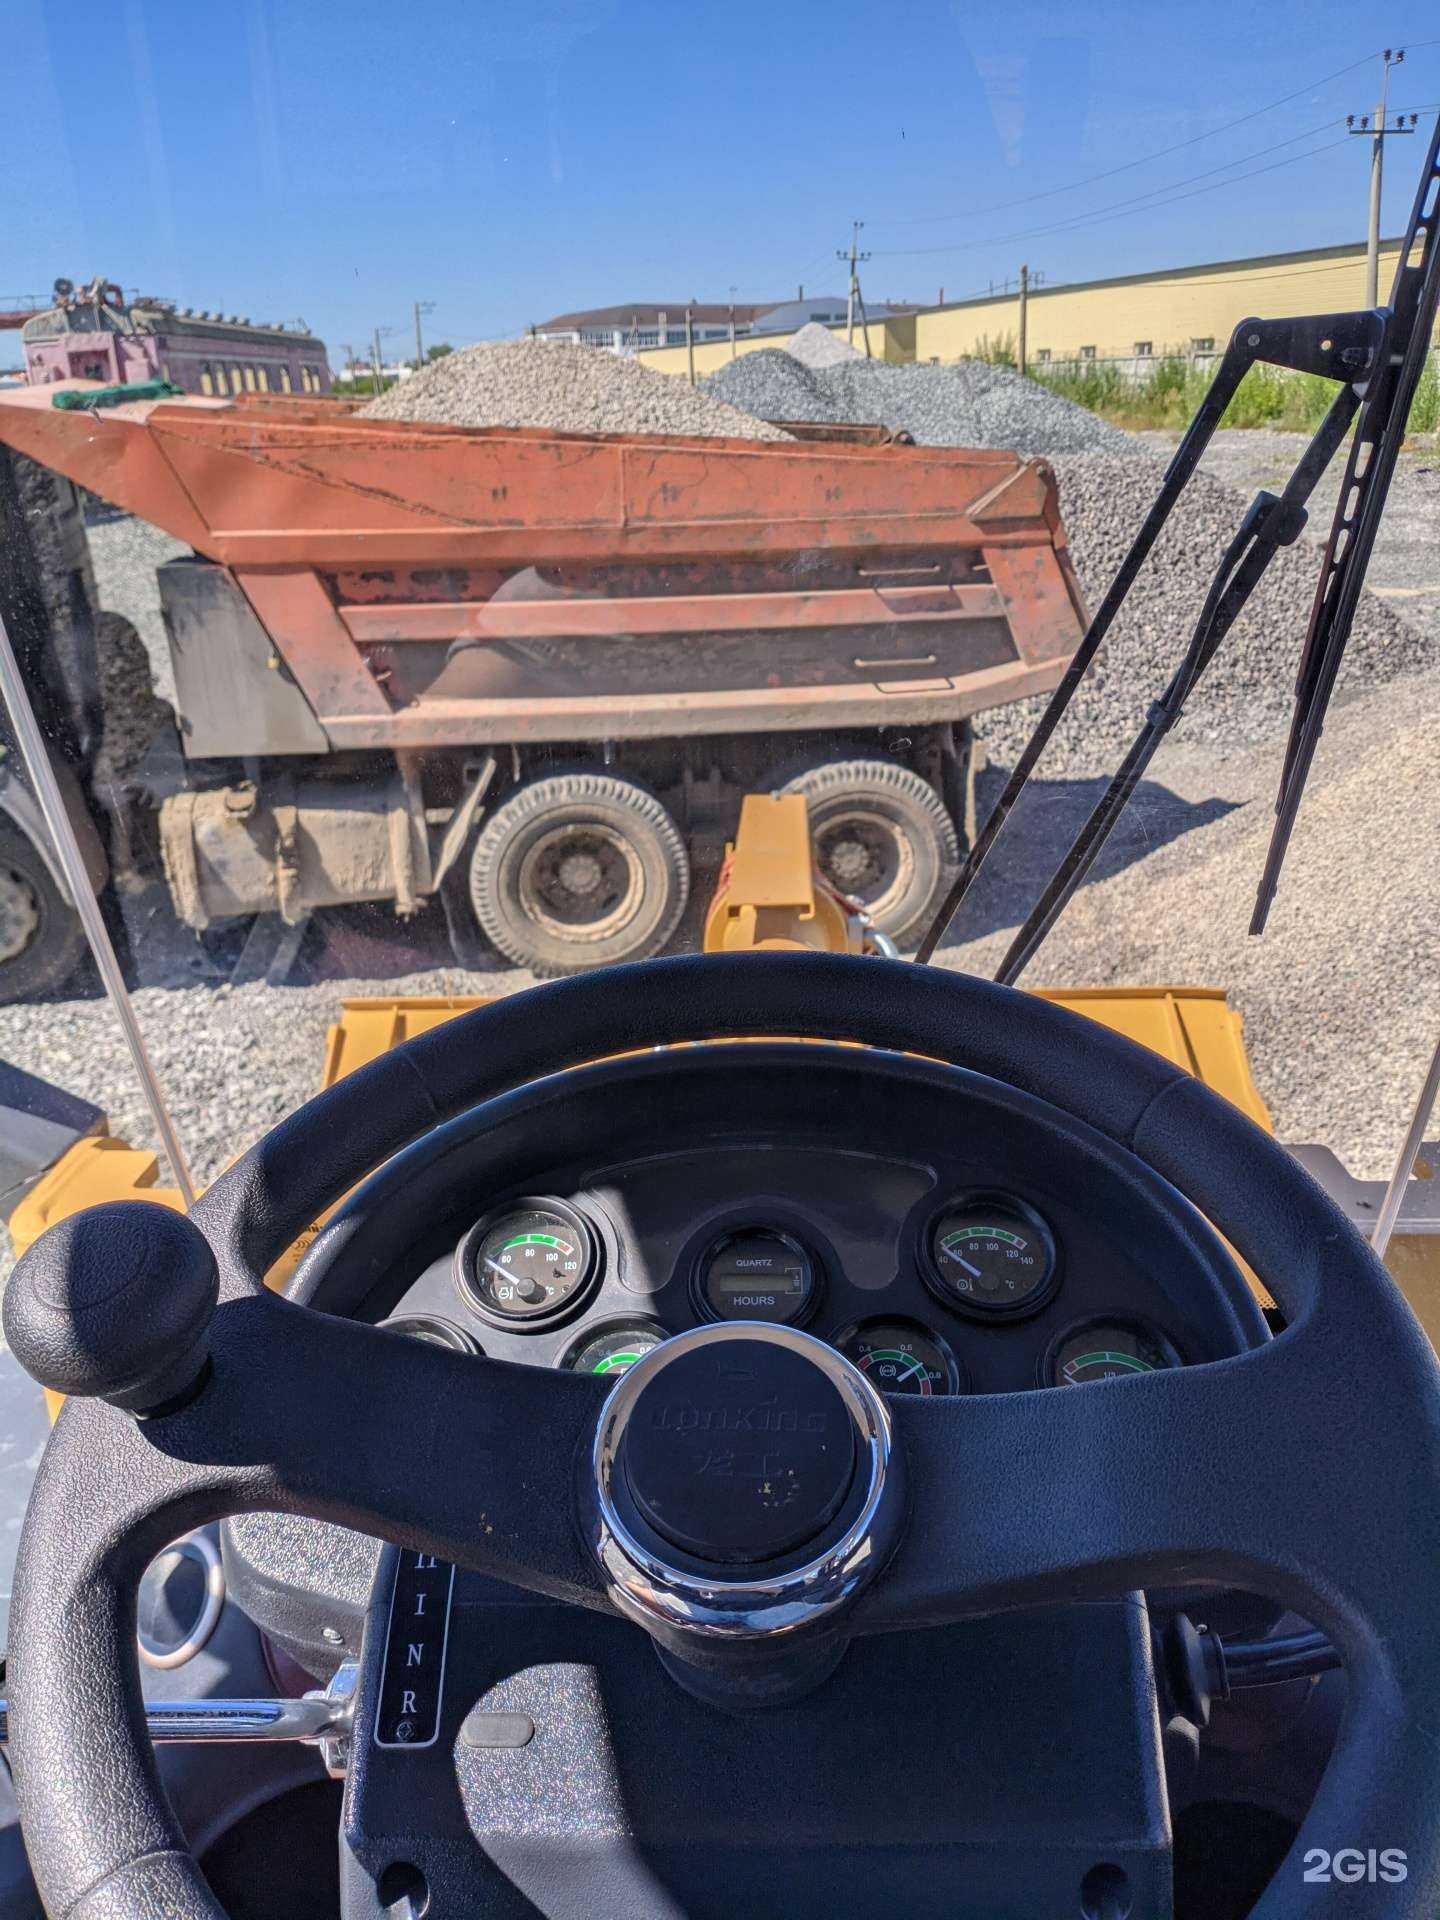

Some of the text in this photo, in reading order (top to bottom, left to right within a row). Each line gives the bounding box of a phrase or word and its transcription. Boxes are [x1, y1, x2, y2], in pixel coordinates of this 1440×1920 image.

[525, 1249, 558, 1262] 80 100
[1006, 1250, 1019, 1258] 120
[736, 1259, 773, 1267] QUARTZ
[1020, 1257, 1034, 1265] 140
[564, 1262, 577, 1270] 120
[733, 1296, 776, 1306] HOURS
[406, 1643, 424, 1667] N
[401, 1690, 417, 1714] R
